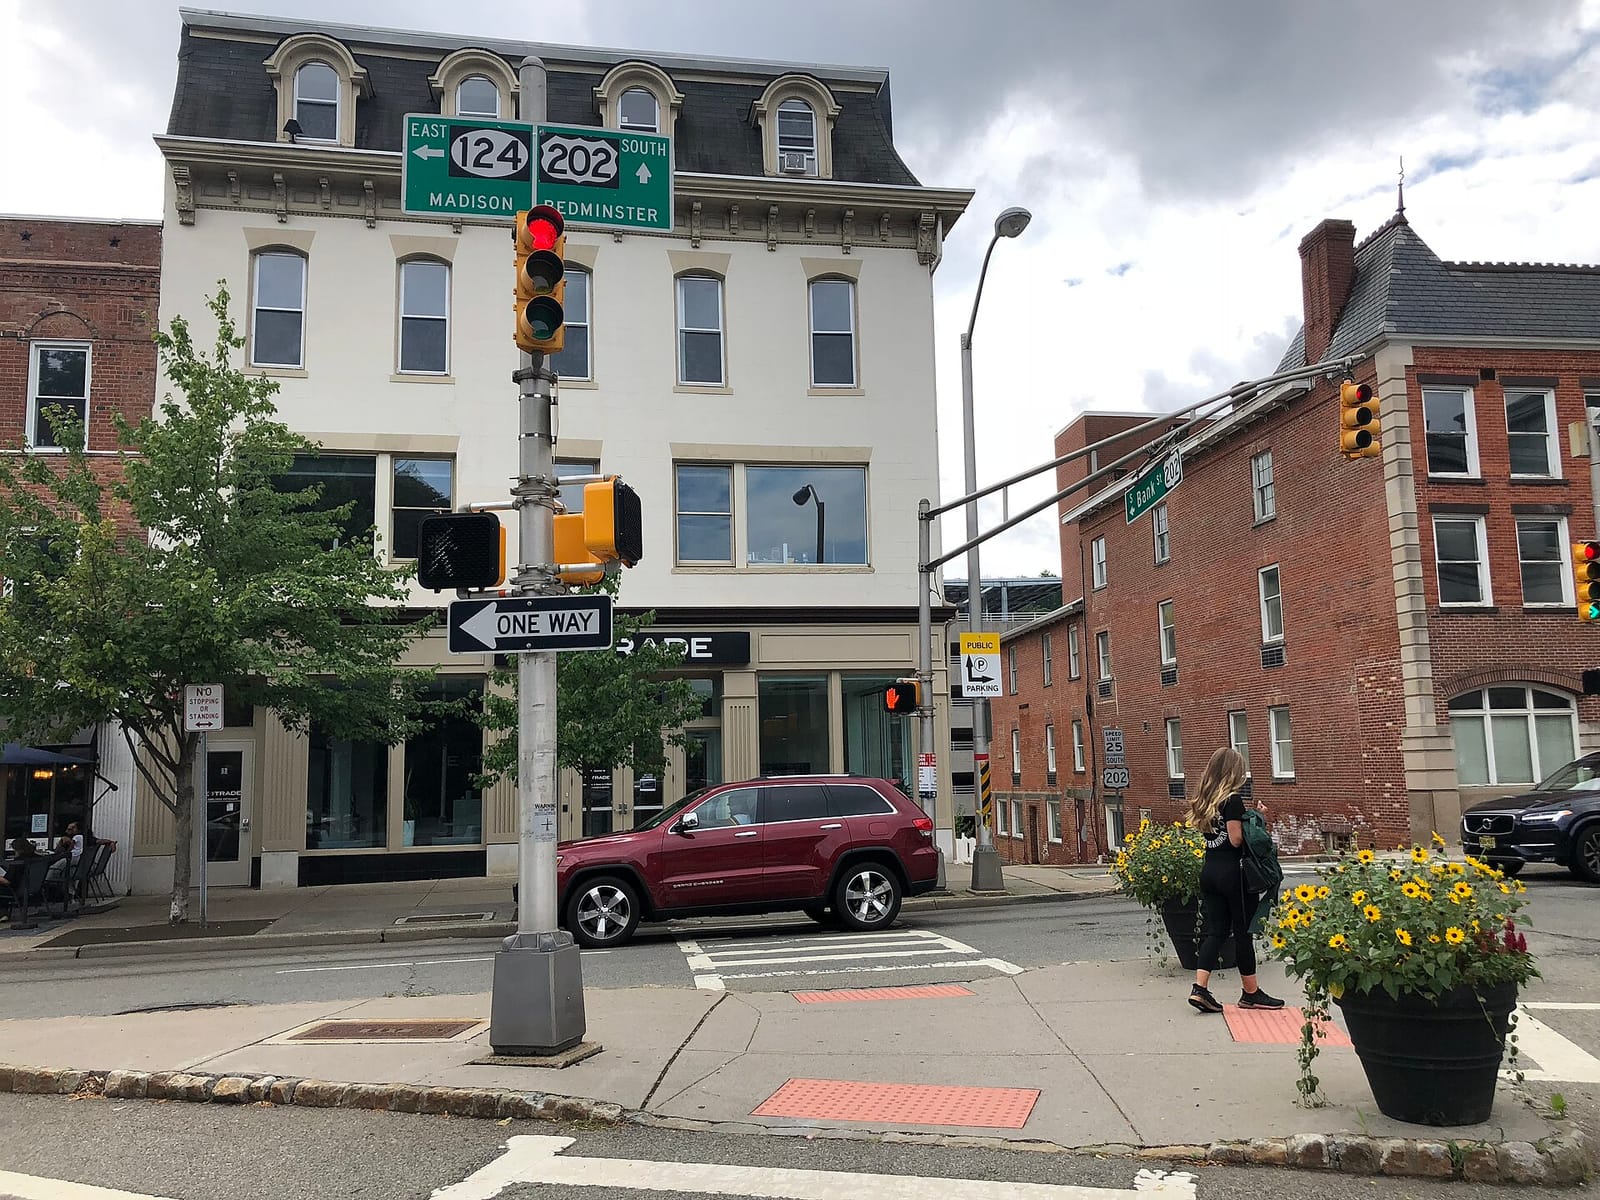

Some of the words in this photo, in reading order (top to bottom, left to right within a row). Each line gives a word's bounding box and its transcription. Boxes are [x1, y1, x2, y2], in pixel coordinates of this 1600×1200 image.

[411, 123, 447, 138] EAST
[459, 136, 522, 171] 124
[621, 139, 666, 157] SOUTH
[547, 143, 612, 179] 202
[429, 192, 513, 210] MADISON
[1164, 458, 1180, 484] 202
[1136, 481, 1156, 508] Bank
[497, 613, 540, 635] ONE
[549, 612, 593, 633] WAY
[977, 660, 985, 669] P
[196, 687, 212, 696] NO
[1106, 742, 1123, 752] 25
[1105, 771, 1127, 784] 202
